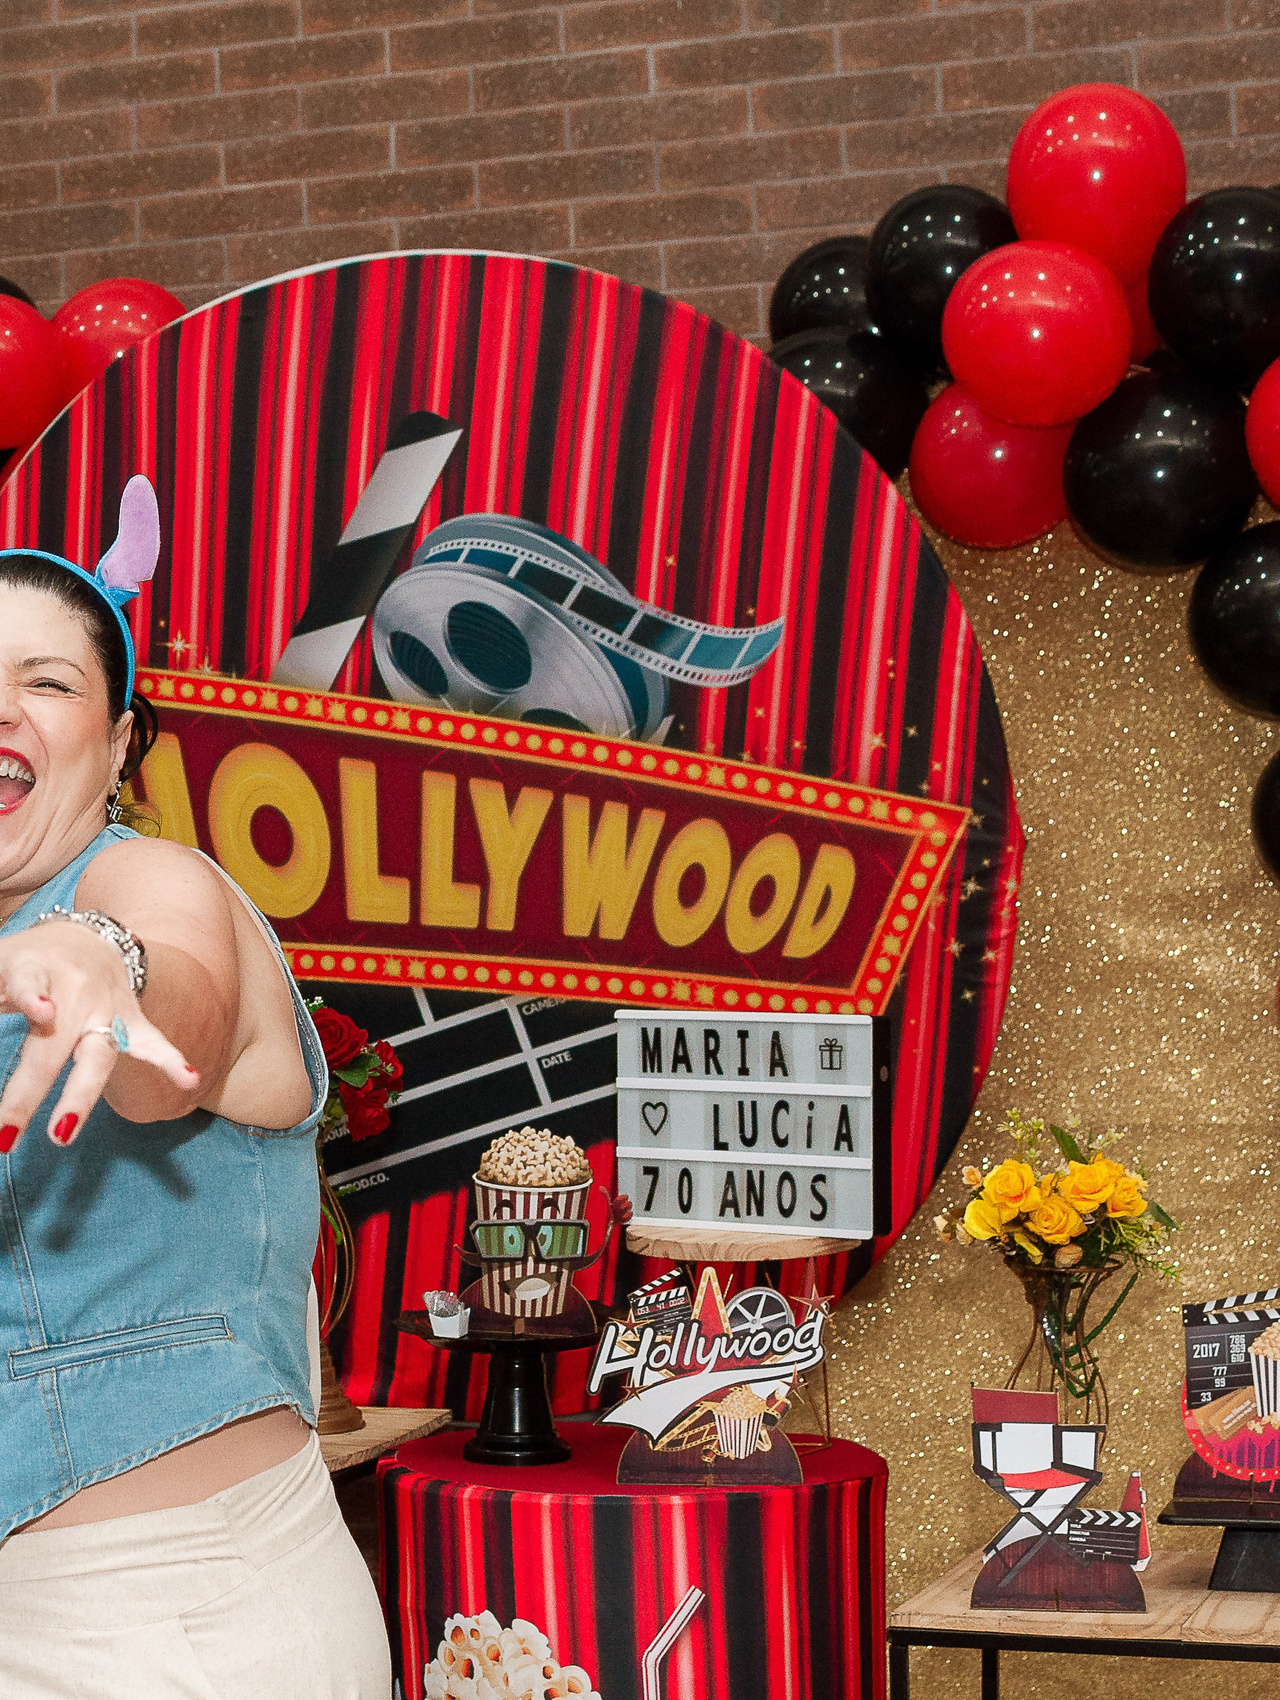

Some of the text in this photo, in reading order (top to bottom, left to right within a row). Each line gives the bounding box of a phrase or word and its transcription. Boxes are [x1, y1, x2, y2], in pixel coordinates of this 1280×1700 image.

[541, 1051, 573, 1069] DATE
[640, 1027, 789, 1077] MARIA
[641, 1165, 829, 1222] 70 ANOS
[588, 1303, 827, 1393] Hollywood
[1192, 1343, 1221, 1359] 2017
[1200, 1392, 1212, 1402] 33
